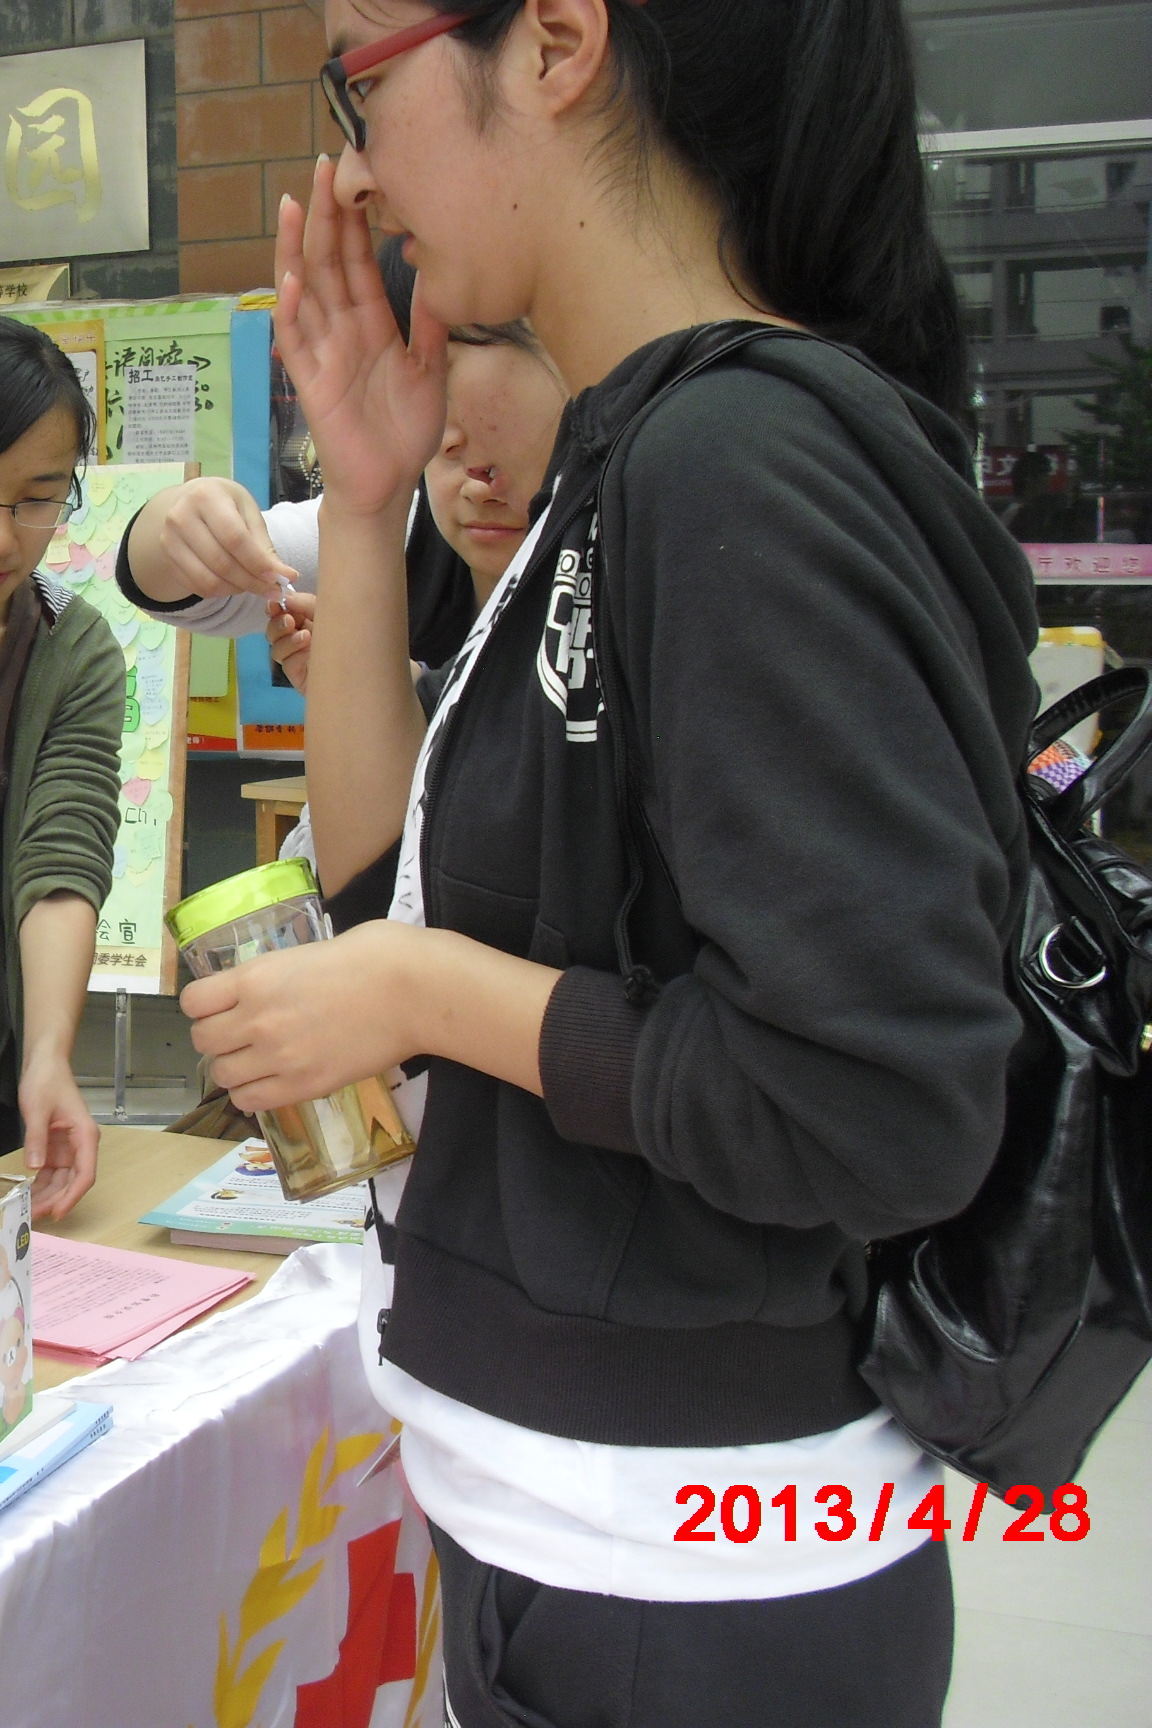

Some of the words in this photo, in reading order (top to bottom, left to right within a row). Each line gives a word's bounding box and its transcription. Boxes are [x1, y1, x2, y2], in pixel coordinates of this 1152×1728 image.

[105, 340, 183, 376] 语阅读
[128, 369, 154, 384] 招工
[16, 1231, 30, 1249] LED
